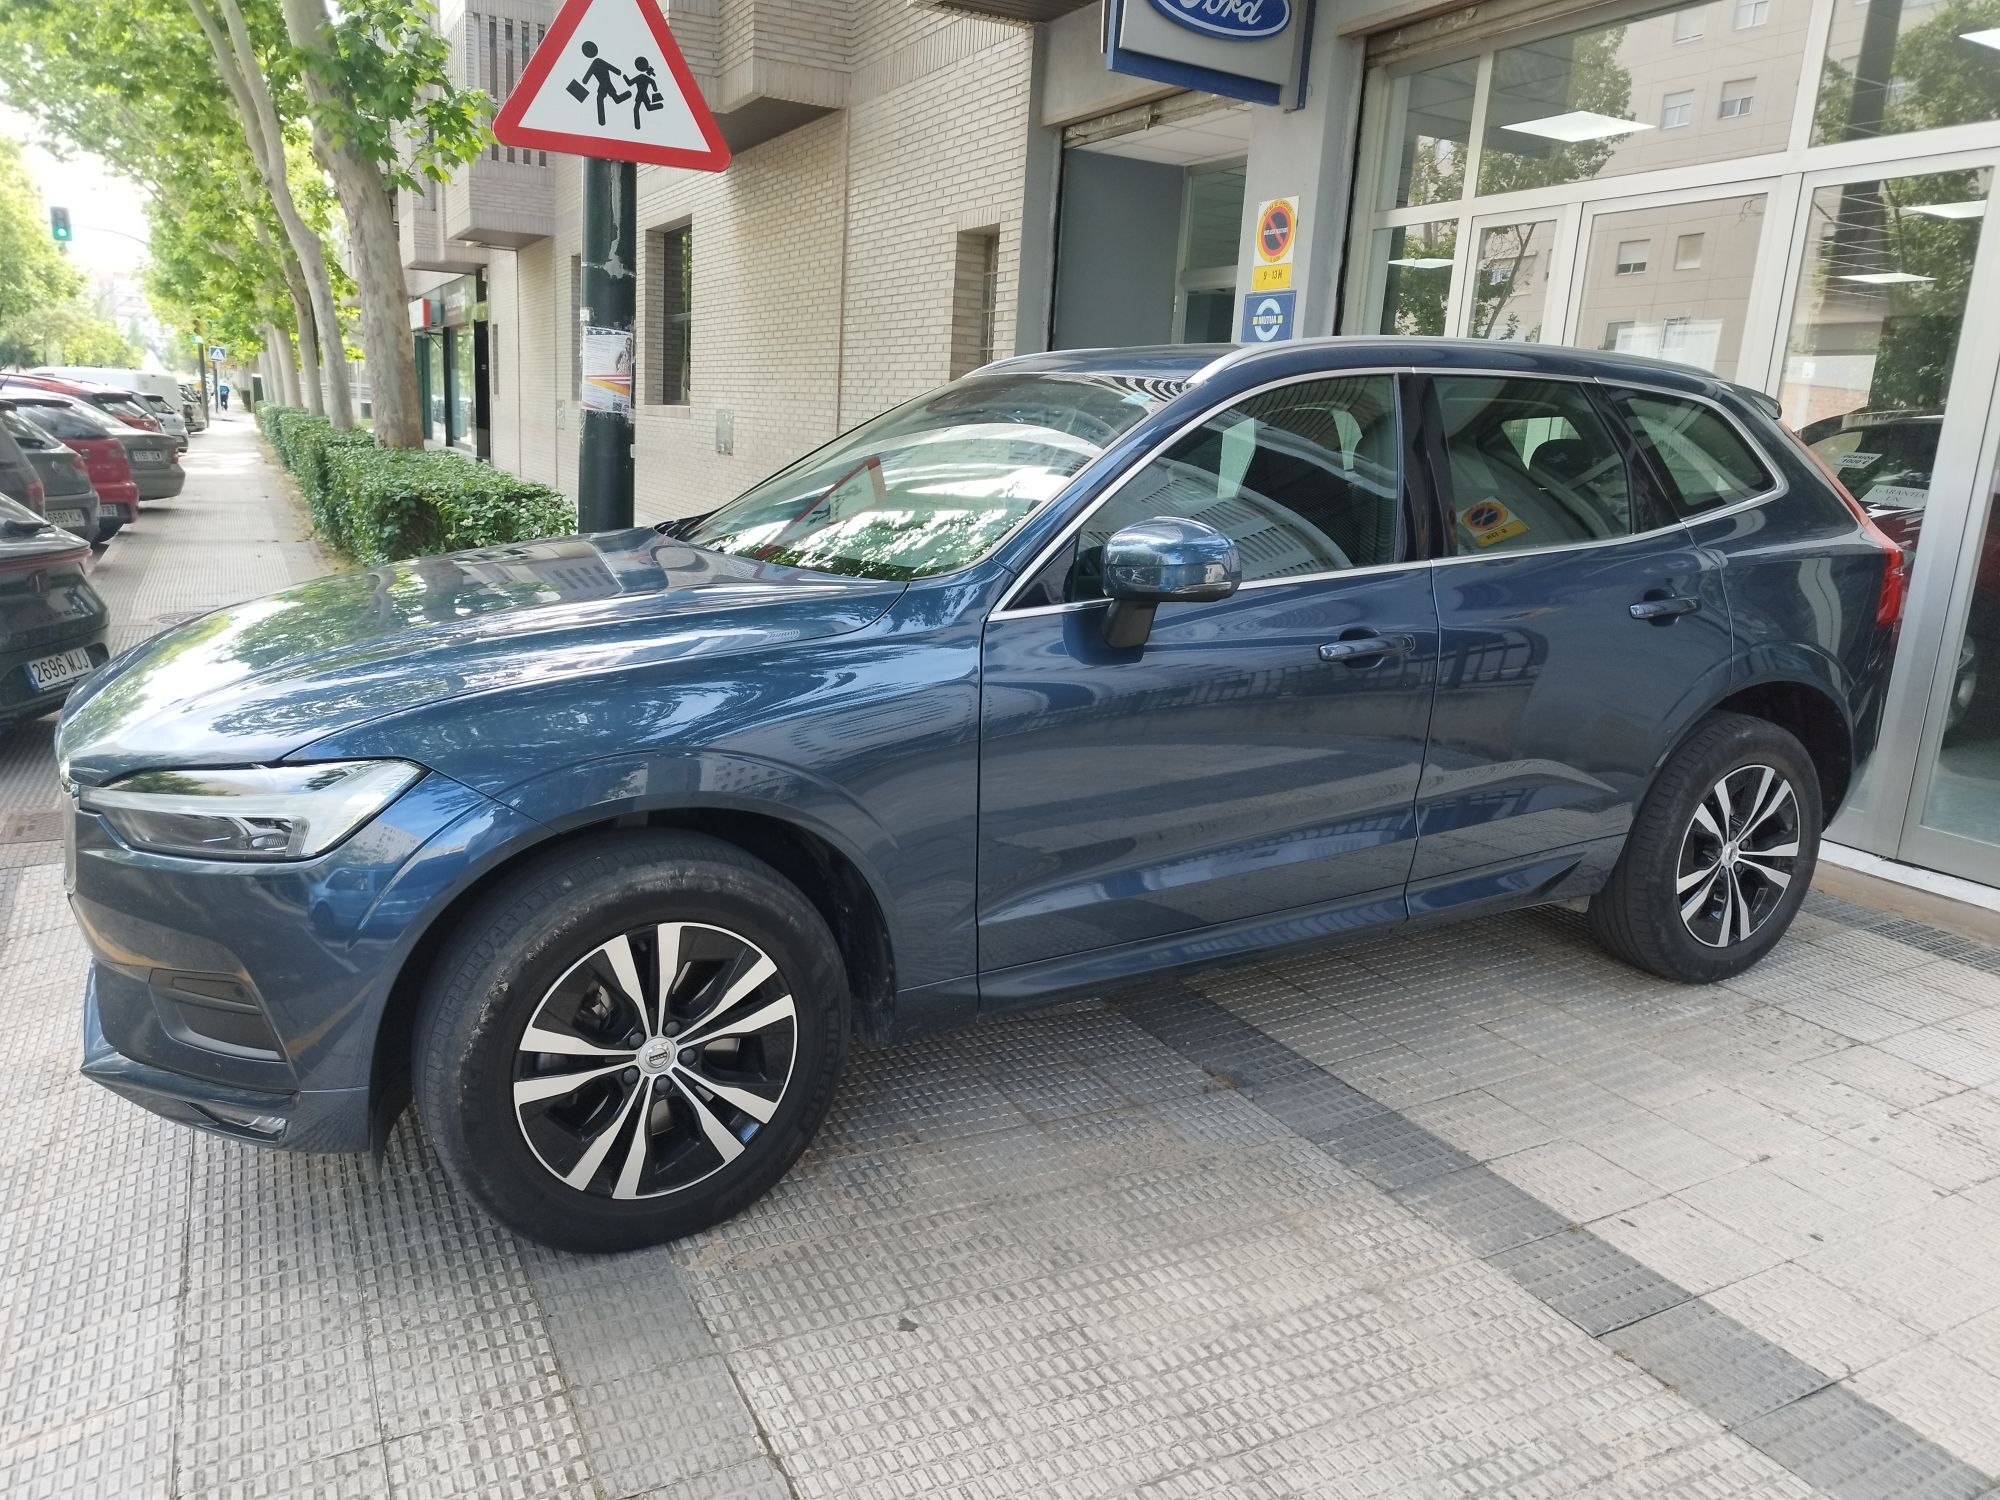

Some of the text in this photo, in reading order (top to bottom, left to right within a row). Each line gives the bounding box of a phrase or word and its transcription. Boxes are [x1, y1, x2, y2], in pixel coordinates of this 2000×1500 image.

[1180, 0, 1262, 25] ord
[32, 649, 89, 683] 2696 MJJ
